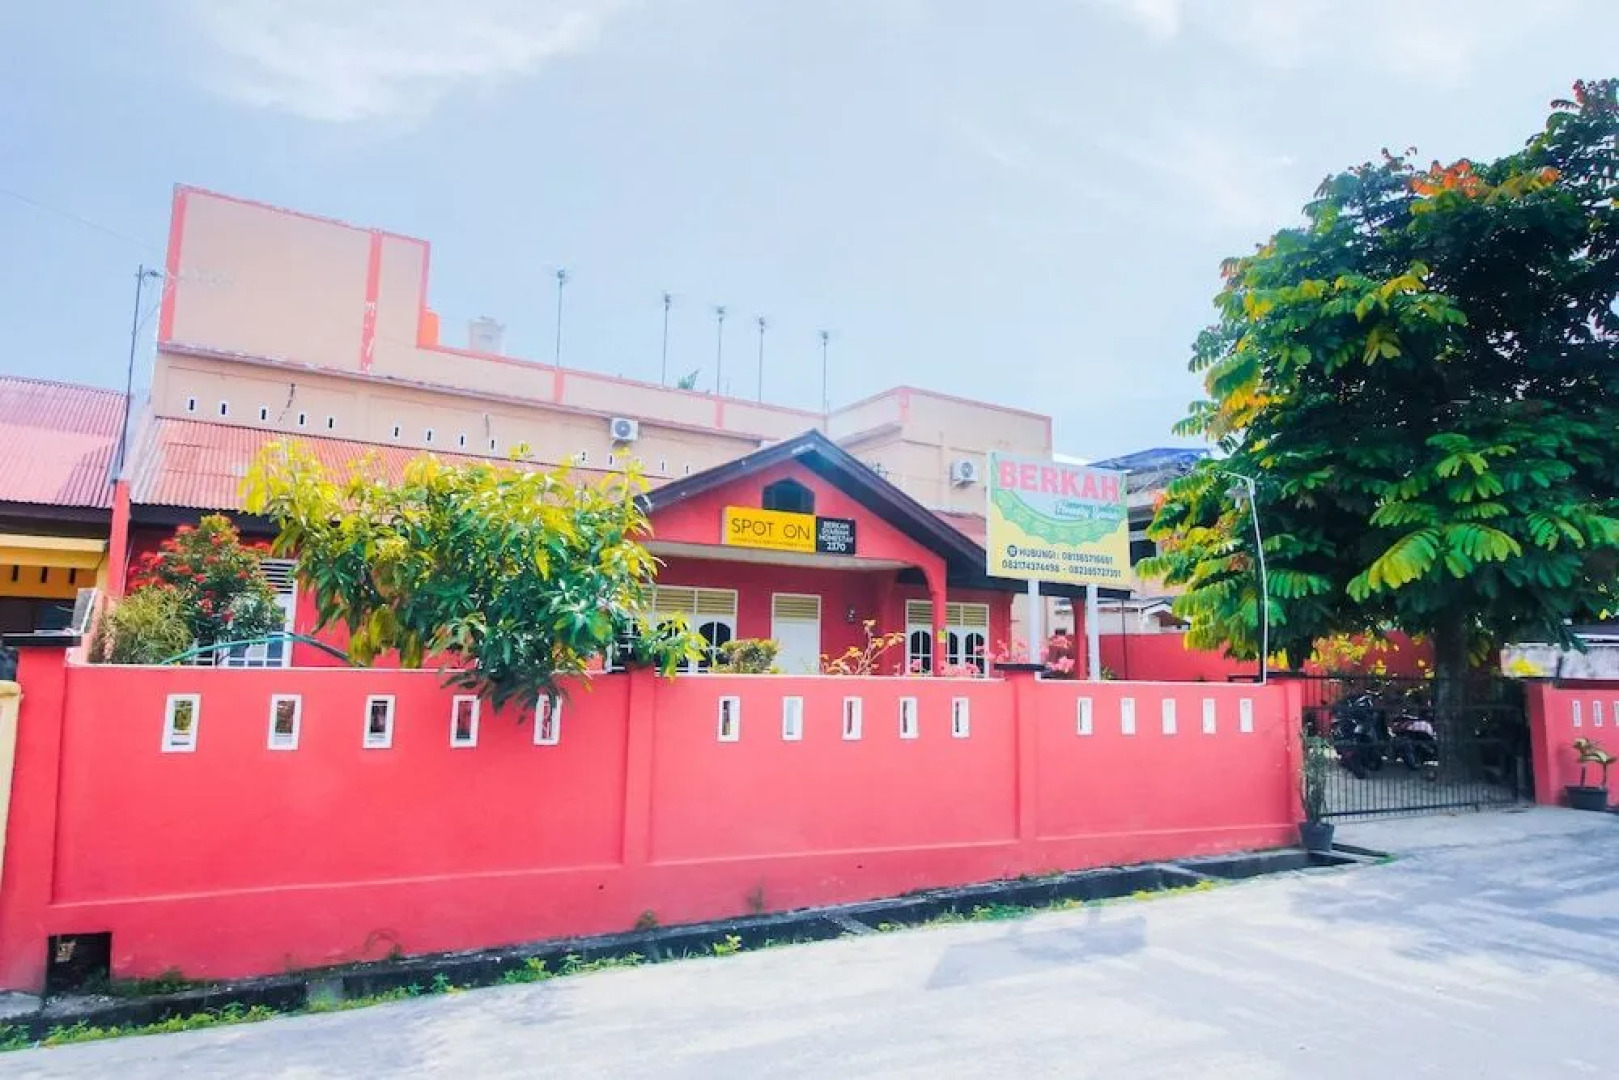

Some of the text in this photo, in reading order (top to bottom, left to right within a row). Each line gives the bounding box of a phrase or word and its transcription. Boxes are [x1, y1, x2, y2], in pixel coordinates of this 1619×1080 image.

[999, 461, 1119, 502] BERKAH
[731, 517, 810, 540] SPOT ON
